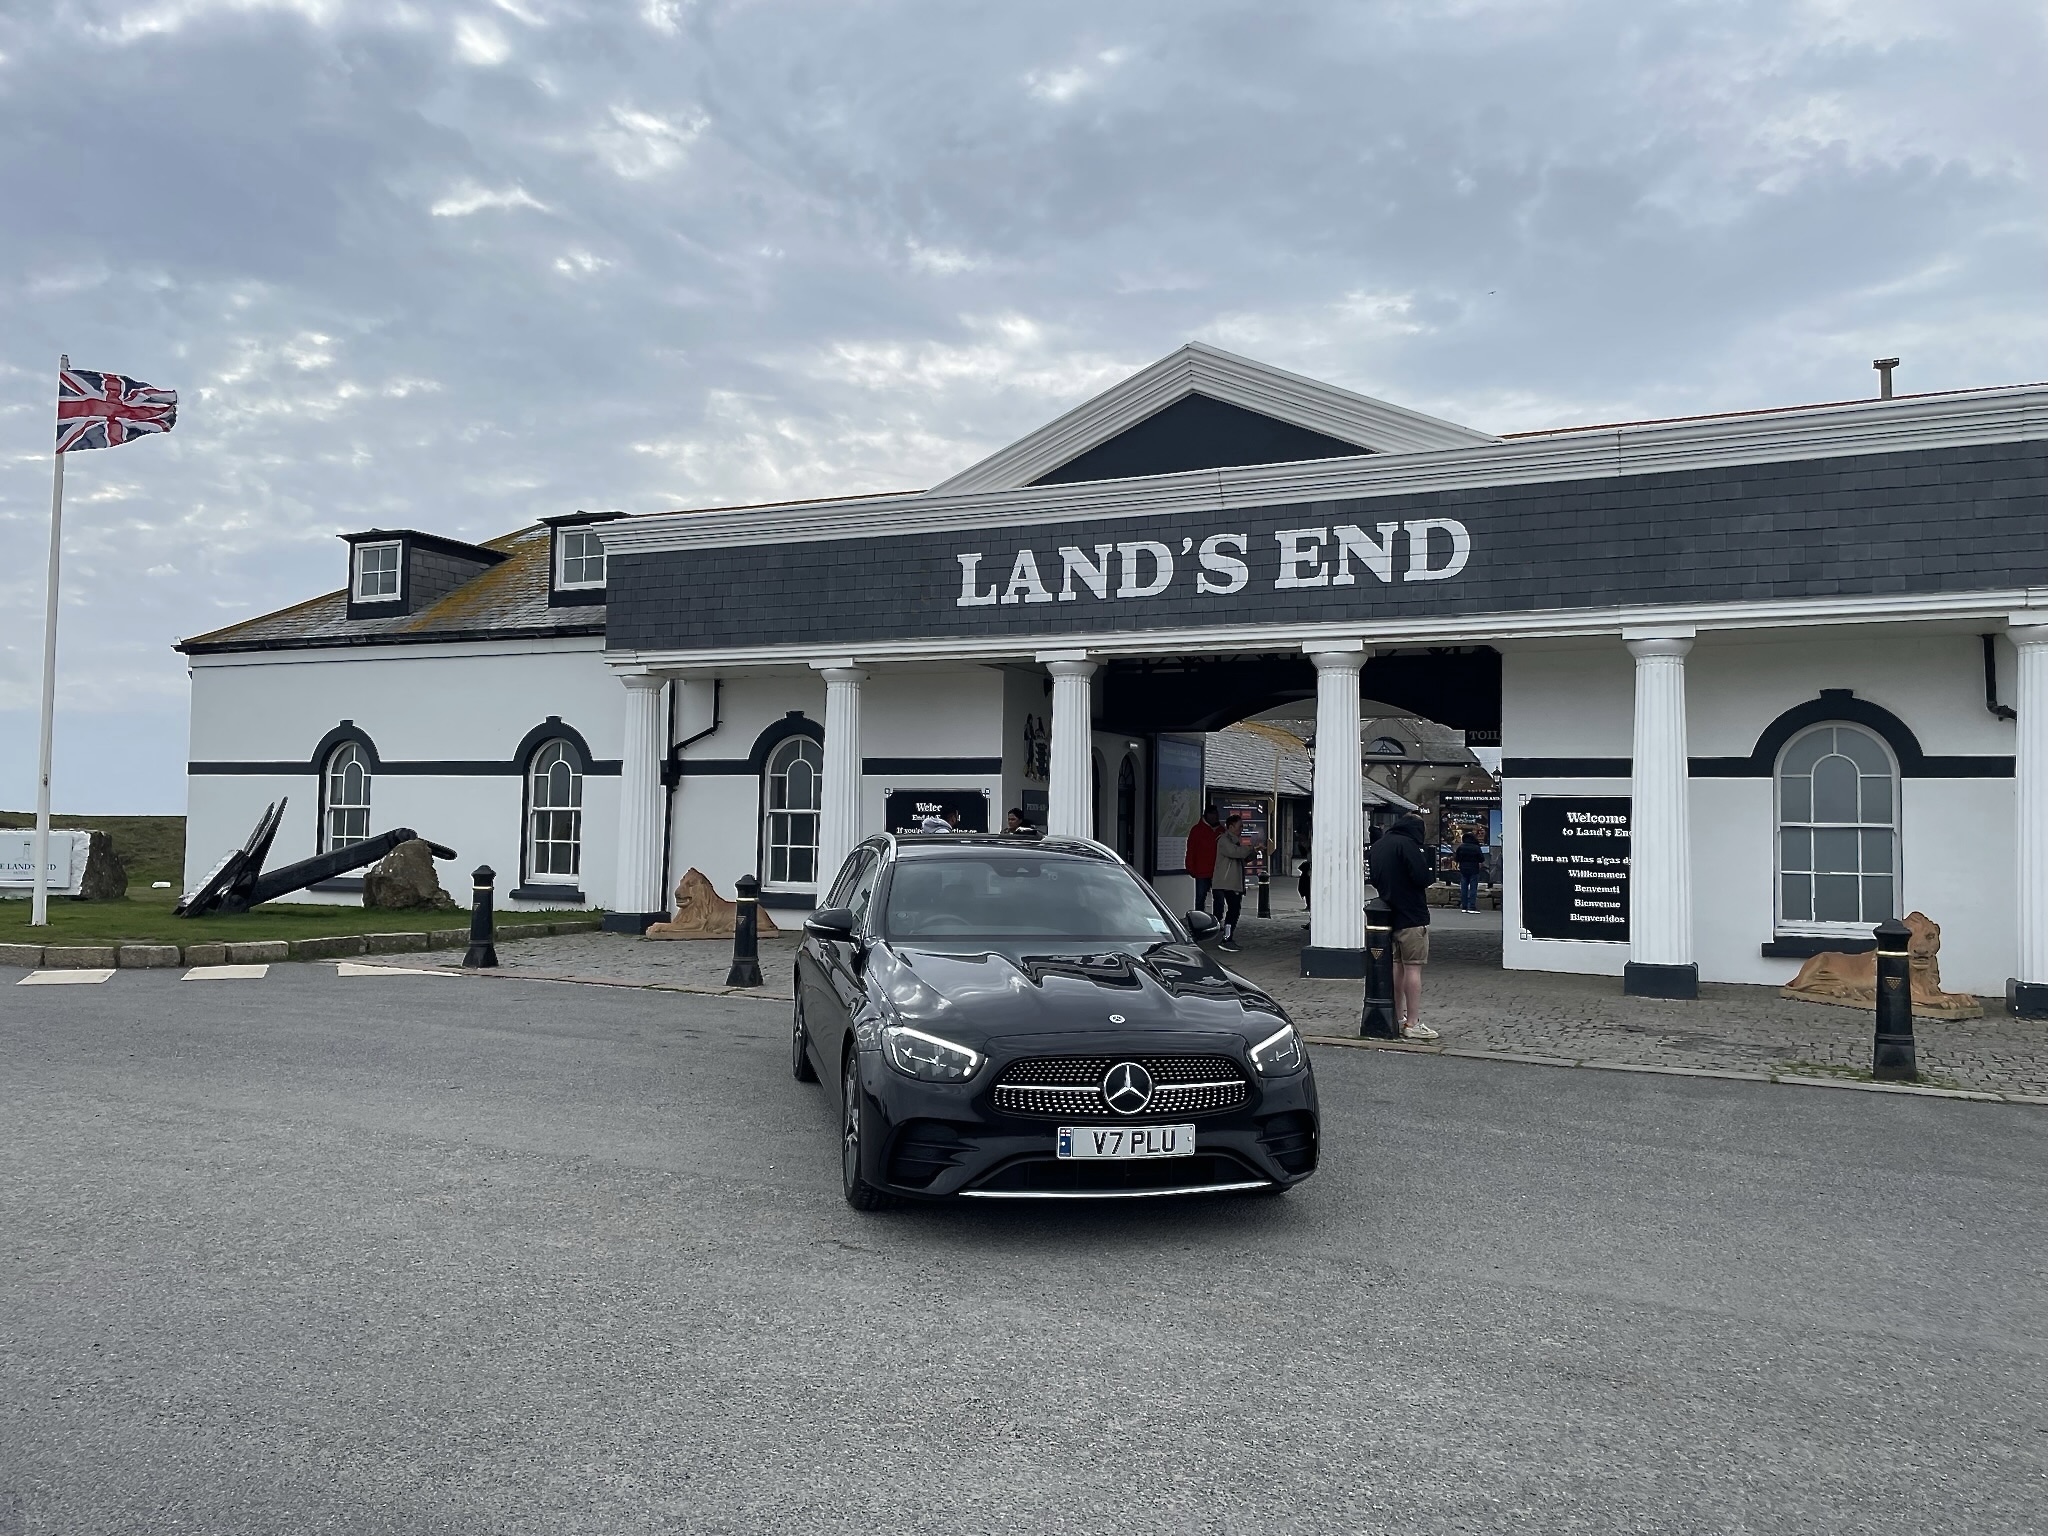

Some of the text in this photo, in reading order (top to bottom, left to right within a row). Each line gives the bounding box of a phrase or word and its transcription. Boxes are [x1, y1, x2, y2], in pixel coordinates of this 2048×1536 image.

[956, 518, 1471, 606] LAND'S END
[1469, 730, 1501, 740] TOIL
[1566, 811, 1627, 824] Welcome
[1562, 828, 1574, 836] to
[1576, 828, 1612, 836] Land's
[1530, 854, 1554, 862] Penn
[1556, 855, 1569, 863] an
[1571, 855, 1595, 863] Wlas
[1568, 869, 1627, 879] Willkommen
[1574, 884, 1620, 894] Benvenuti
[1574, 899, 1621, 908] Bienvenue
[1570, 913, 1625, 923] Bienvenidos
[1092, 1128, 1176, 1155] V7 PLU
